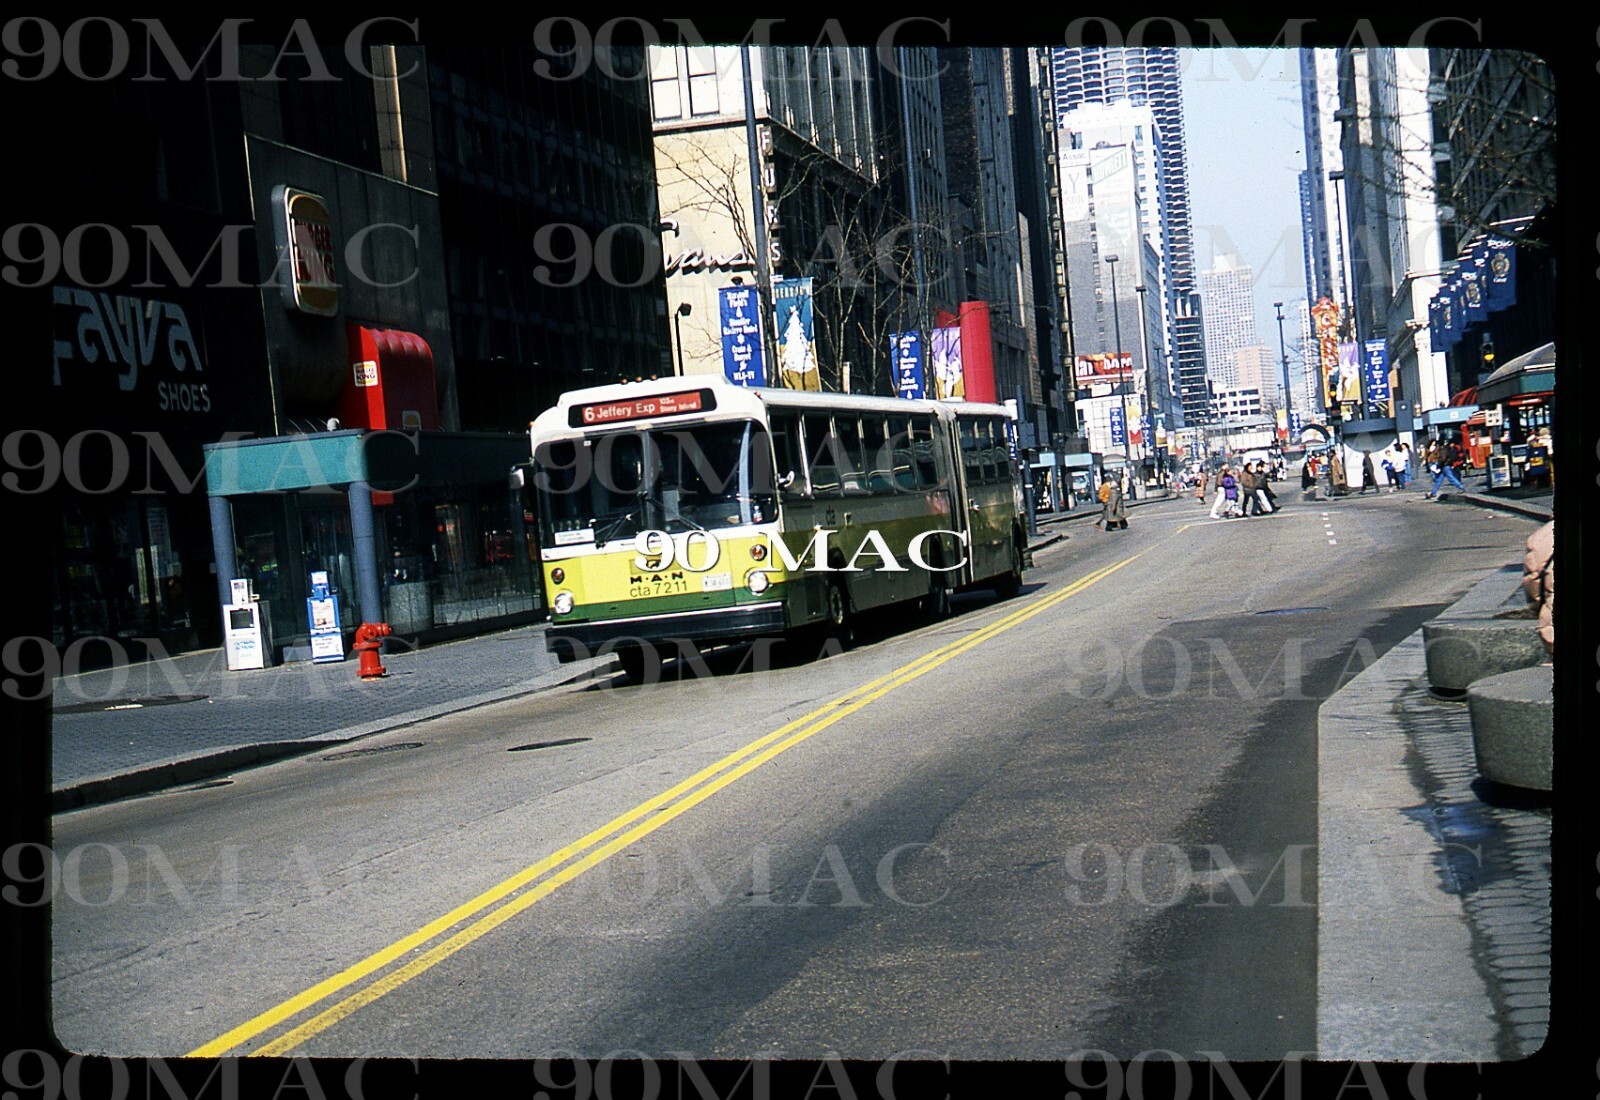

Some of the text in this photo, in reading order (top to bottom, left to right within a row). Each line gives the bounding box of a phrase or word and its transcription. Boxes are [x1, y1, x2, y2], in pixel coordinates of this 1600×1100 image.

[157, 381, 211, 413] SHOES
[584, 403, 656, 422] 6 Jeffery Exp
[630, 584, 651, 598] cta
[654, 580, 689, 595] 7211
